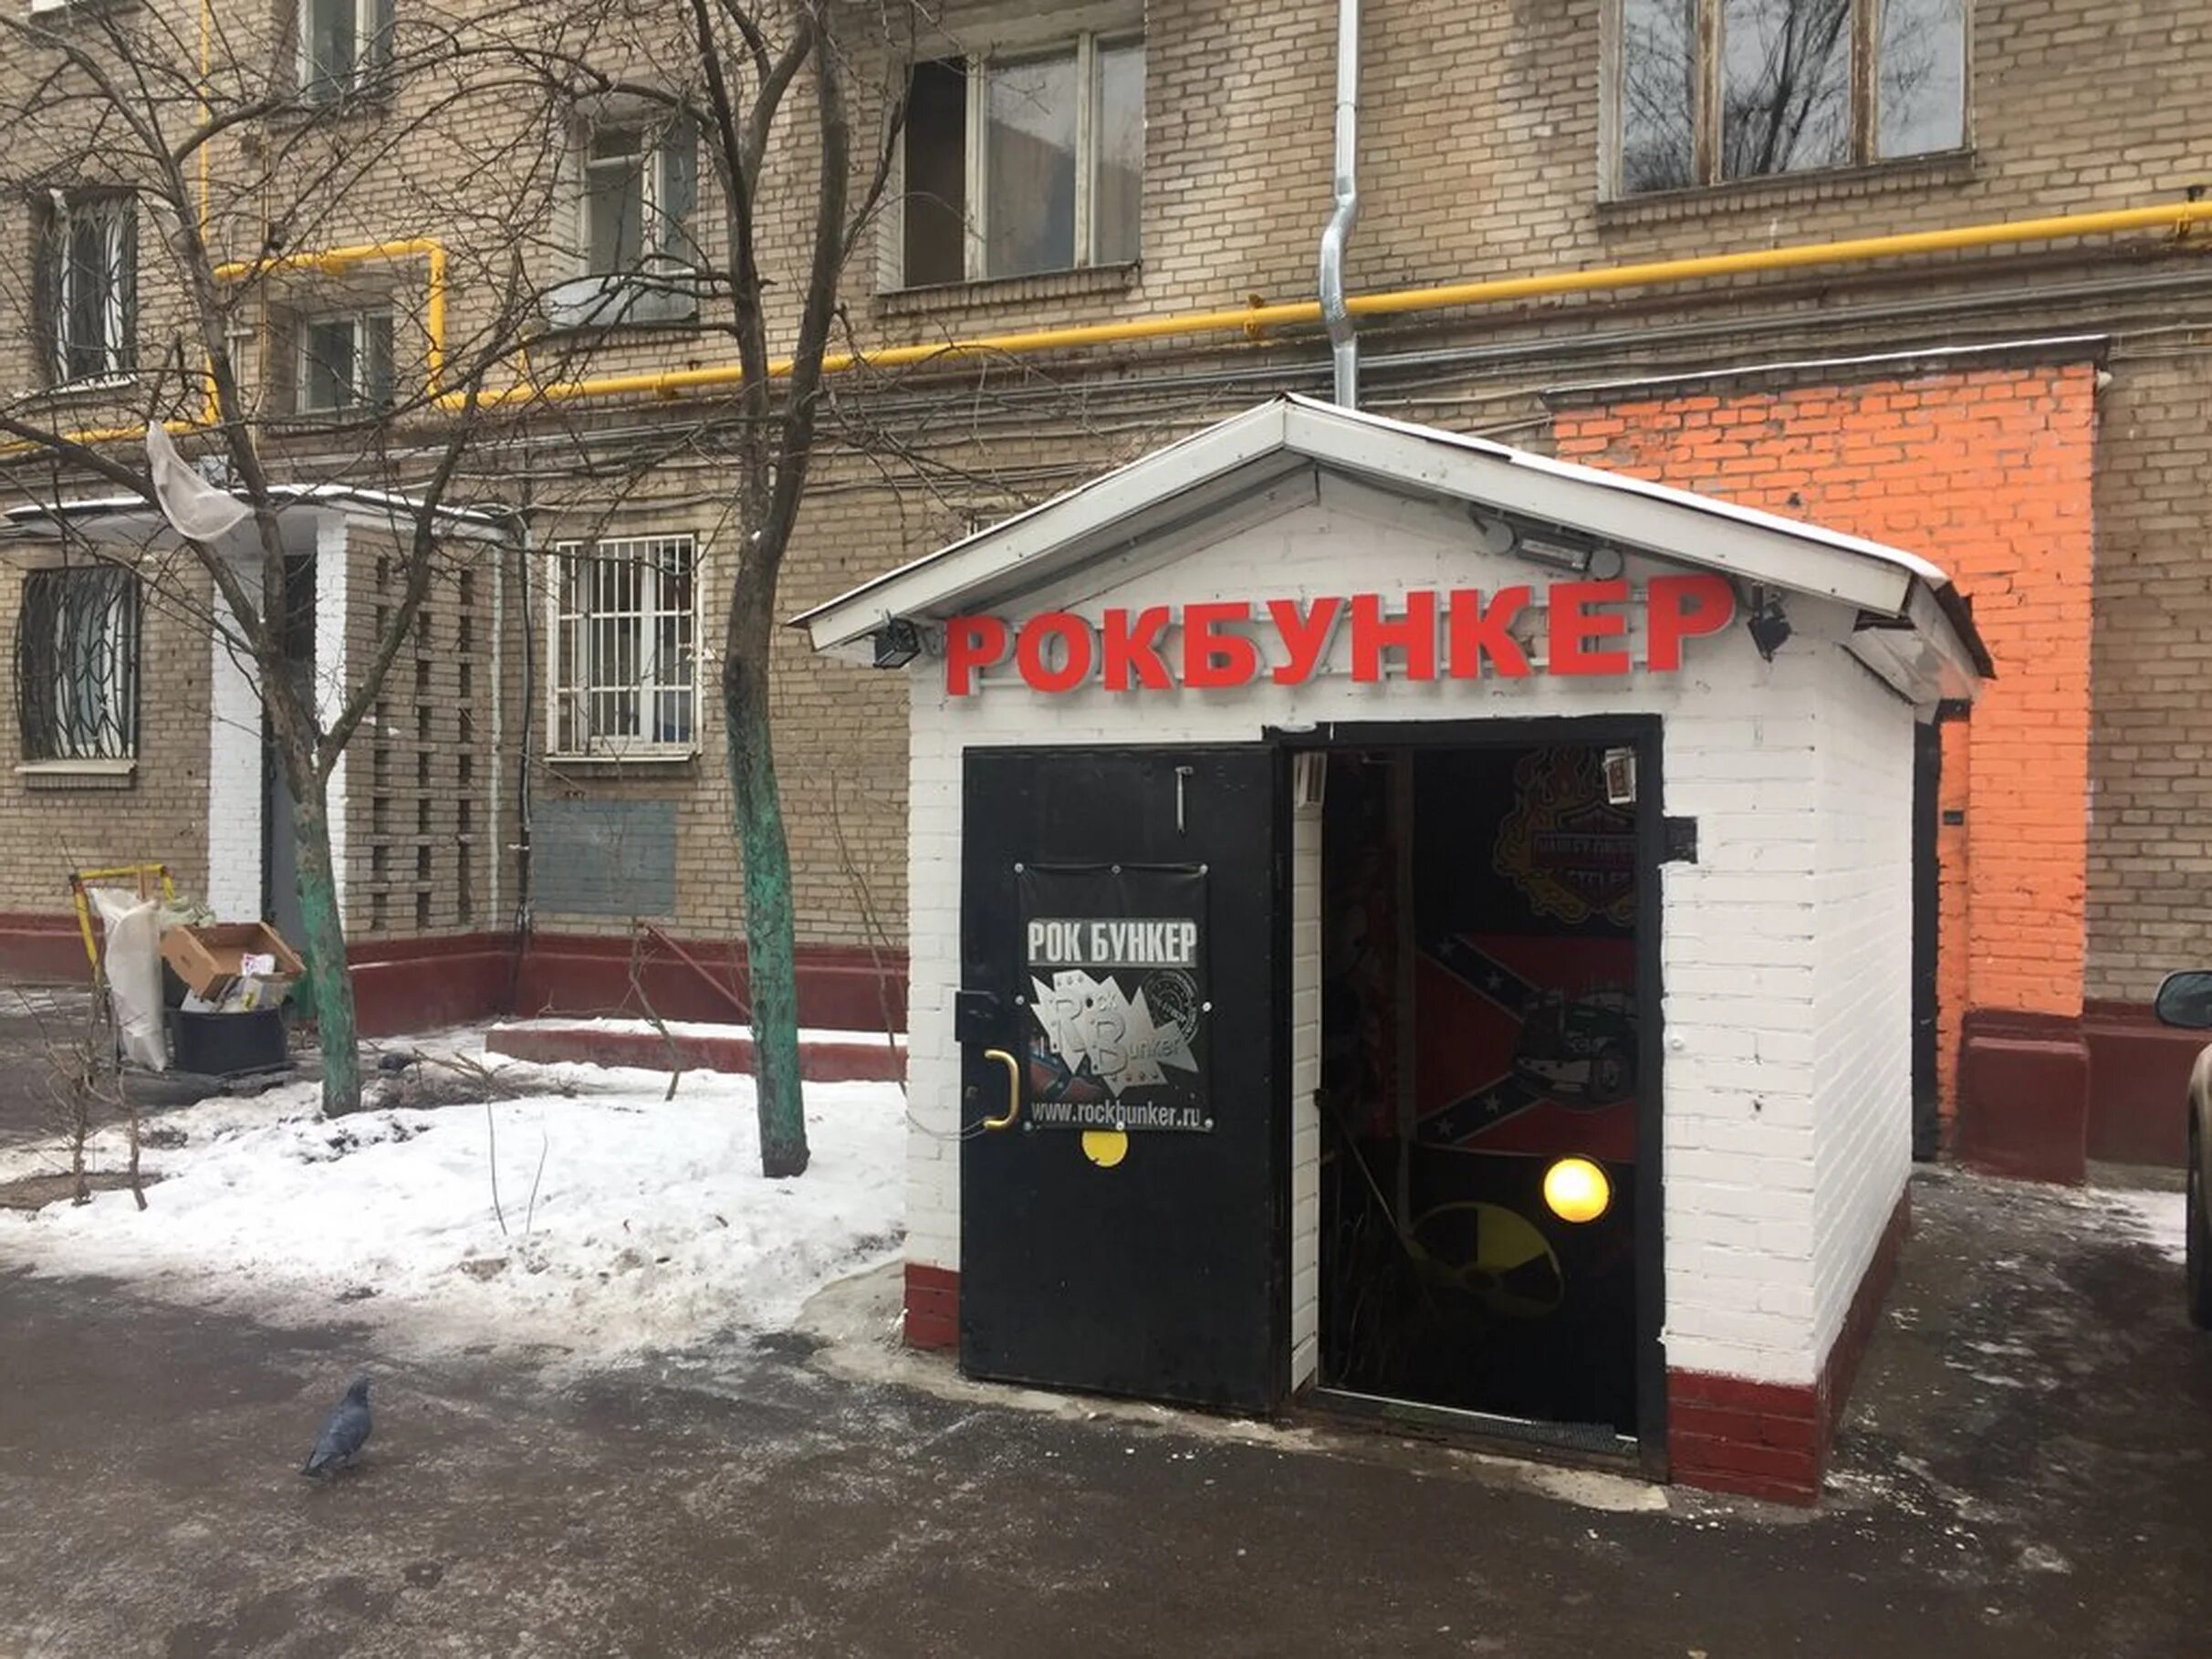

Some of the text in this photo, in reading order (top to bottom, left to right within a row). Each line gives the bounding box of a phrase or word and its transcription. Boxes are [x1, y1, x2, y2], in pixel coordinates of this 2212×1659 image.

[946, 575, 1737, 696] РОКБУНКЕР
[1028, 922, 1197, 963] РОК БУНКЕР
[1031, 1100, 1201, 1128] www.rockbunker.ru
